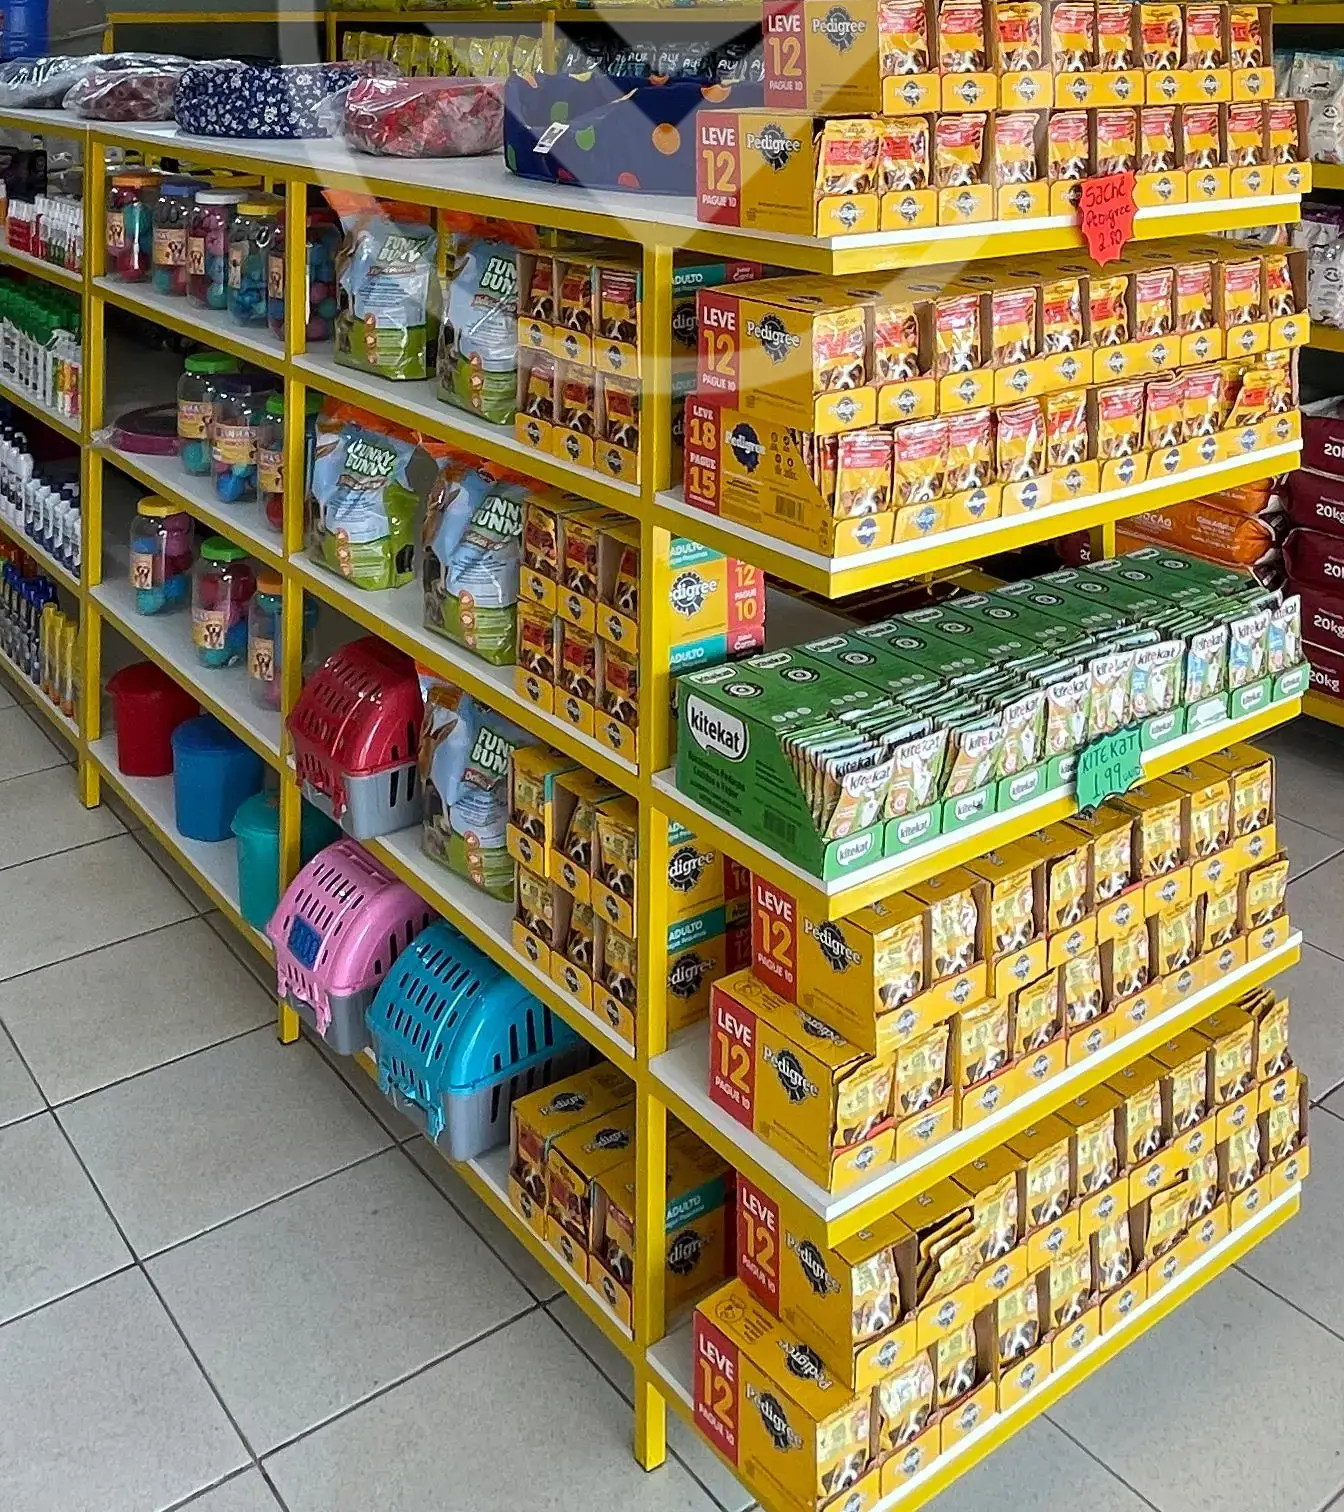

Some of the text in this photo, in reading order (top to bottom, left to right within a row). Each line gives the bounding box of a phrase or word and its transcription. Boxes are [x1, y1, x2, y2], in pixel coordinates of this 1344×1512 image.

[768, 14, 801, 33] LEVE
[811, 17, 867, 36] Pedigree
[768, 37, 802, 77] 12
[702, 127, 736, 146] LEVE
[746, 133, 801, 153] Pedigree
[703, 150, 736, 192] 12
[483, 271, 517, 289] BUN
[488, 258, 517, 274] FUN
[703, 306, 736, 330] LEVE
[746, 319, 800, 347] Pedigree
[705, 330, 736, 376] 12
[690, 419, 716, 451] 18
[689, 467, 716, 498] 15
[735, 564, 756, 587] 12
[669, 580, 717, 601] digree
[736, 599, 757, 621] 10
[1313, 614, 1344, 638] 20kg
[1138, 648, 1176, 665] kitekat
[690, 707, 741, 753] kitekat
[835, 753, 876, 780] kitekat
[900, 820, 929, 839] kitekat
[669, 851, 714, 877] digree
[839, 841, 870, 861] kitekat
[757, 885, 793, 923] LEVE
[757, 909, 794, 968] 12
[804, 916, 862, 965] Pedigree
[669, 957, 716, 986] digree
[717, 1007, 752, 1048] LEVE
[717, 1031, 751, 1094] 12
[762, 1043, 820, 1098] Pedigree
[741, 1187, 776, 1232] LEVE
[742, 1209, 776, 1278] 12
[699, 1334, 734, 1381] LEVE
[699, 1357, 734, 1430] 12
